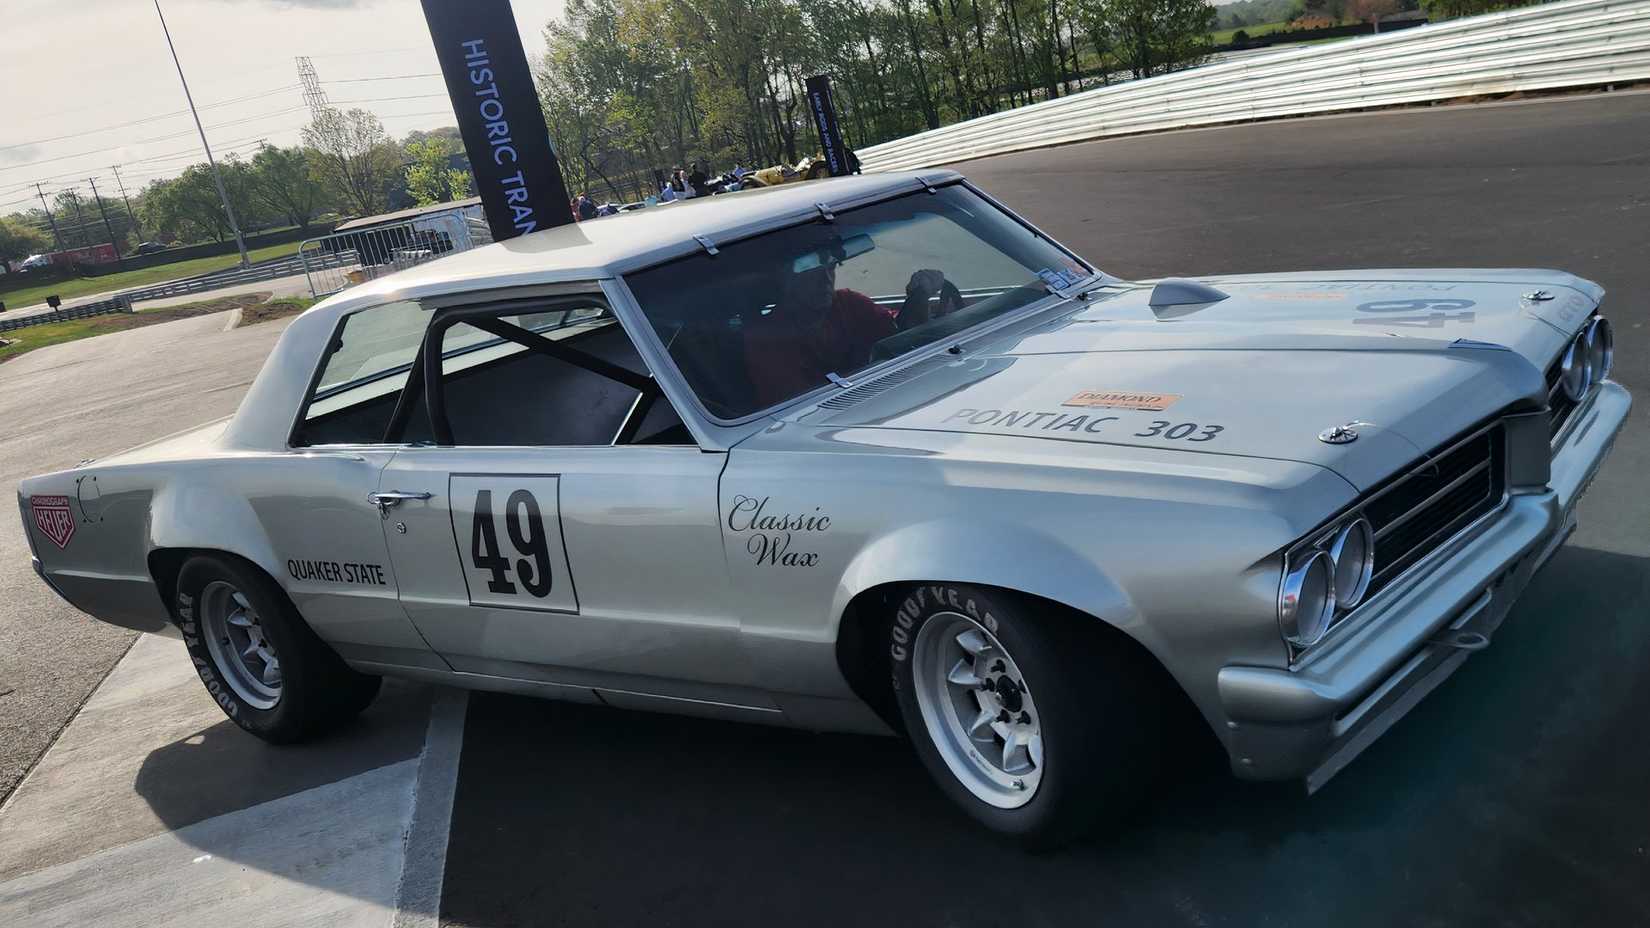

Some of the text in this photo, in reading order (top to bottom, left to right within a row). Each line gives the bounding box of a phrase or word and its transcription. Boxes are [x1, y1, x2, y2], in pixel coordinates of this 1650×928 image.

[462, 39, 518, 165] HISTORIC
[1352, 298, 1477, 329] 49
[942, 407, 1225, 443] PONTIAC 303
[36, 508, 71, 543] HEUER
[728, 494, 832, 532] Classic
[472, 489, 553, 599] 49
[746, 533, 821, 568] Wax
[287, 559, 386, 585] QUAKER STATE
